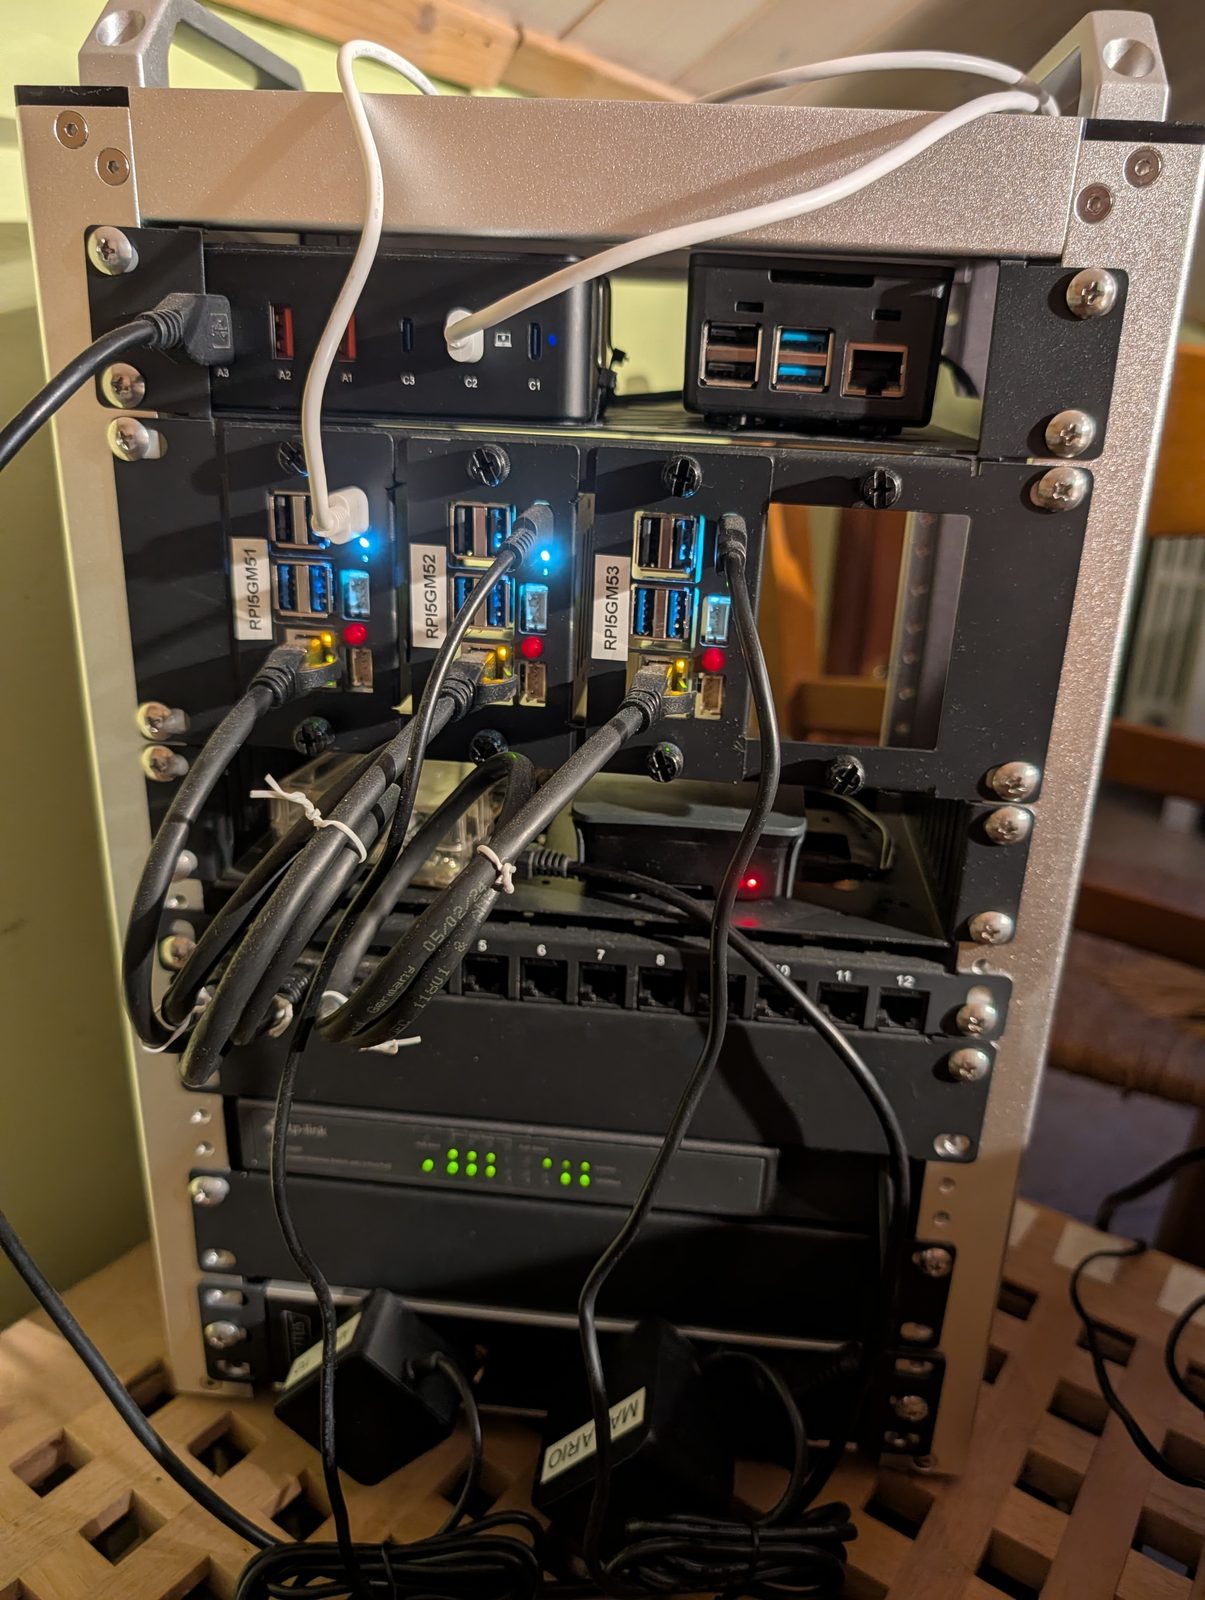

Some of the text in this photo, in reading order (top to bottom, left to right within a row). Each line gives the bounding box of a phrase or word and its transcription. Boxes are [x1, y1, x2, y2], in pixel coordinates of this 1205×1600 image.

[217, 367, 541, 391] A3 A2 A1 C3 C2 C1
[245, 547, 262, 631] RPI5GM51
[422, 552, 439, 640] RPI5GM52
[603, 564, 621, 651] RPI5GM53
[477, 939, 488, 952] 5
[536, 944, 547, 956] 6
[596, 948, 606, 960] 7
[655, 953, 665, 966] 8
[836, 969, 852, 982] 11
[896, 974, 915, 988] 12
